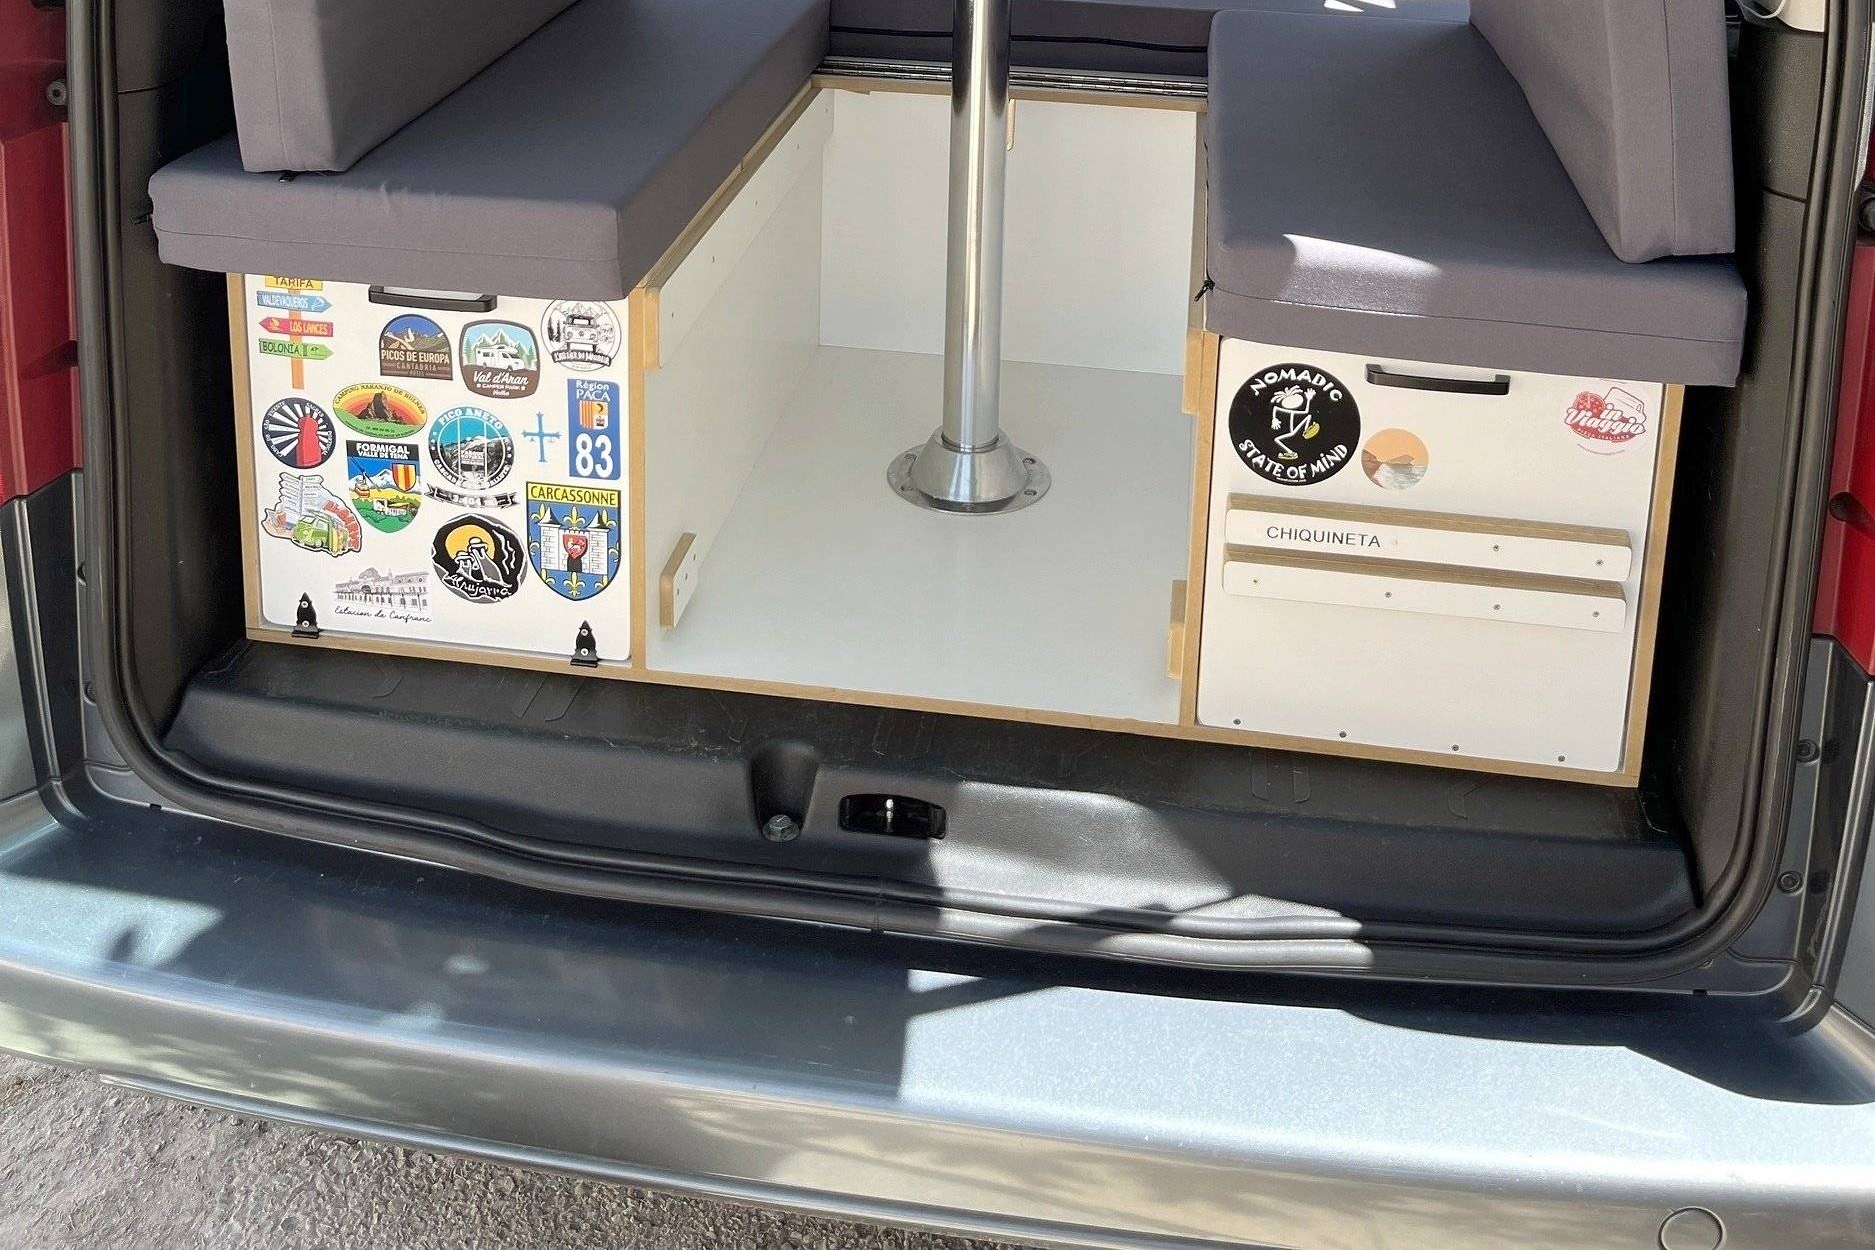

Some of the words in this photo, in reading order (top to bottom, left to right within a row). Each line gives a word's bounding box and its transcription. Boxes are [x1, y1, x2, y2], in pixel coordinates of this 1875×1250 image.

[273, 276, 314, 289] TARIFA
[290, 320, 302, 333] LOS
[304, 322, 328, 335] LANCES
[381, 350, 405, 361] PICOS
[406, 351, 418, 362] DE
[418, 352, 450, 364] EUROPA
[473, 371, 492, 383] Val
[492, 372, 529, 386] d'Aran
[576, 380, 609, 392] Région
[1250, 368, 1343, 402] NOMADIC
[335, 385, 360, 405] CAMPING
[576, 389, 611, 401] PACA
[438, 408, 463, 426] PICO
[465, 408, 504, 430] ANETO
[1565, 407, 1647, 435] Viaggio
[1600, 403, 1623, 422] in
[356, 442, 411, 454] FORMIGAL
[358, 450, 379, 458] VALLE
[575, 433, 614, 478] 83
[1238, 439, 1285, 477] STATE
[1286, 463, 1308, 479] OF
[530, 485, 616, 506] CARCASSONNE
[1266, 525, 1381, 548] CHIQUINETA
[374, 608, 386, 619] de
[389, 611, 433, 624] Canfranc
